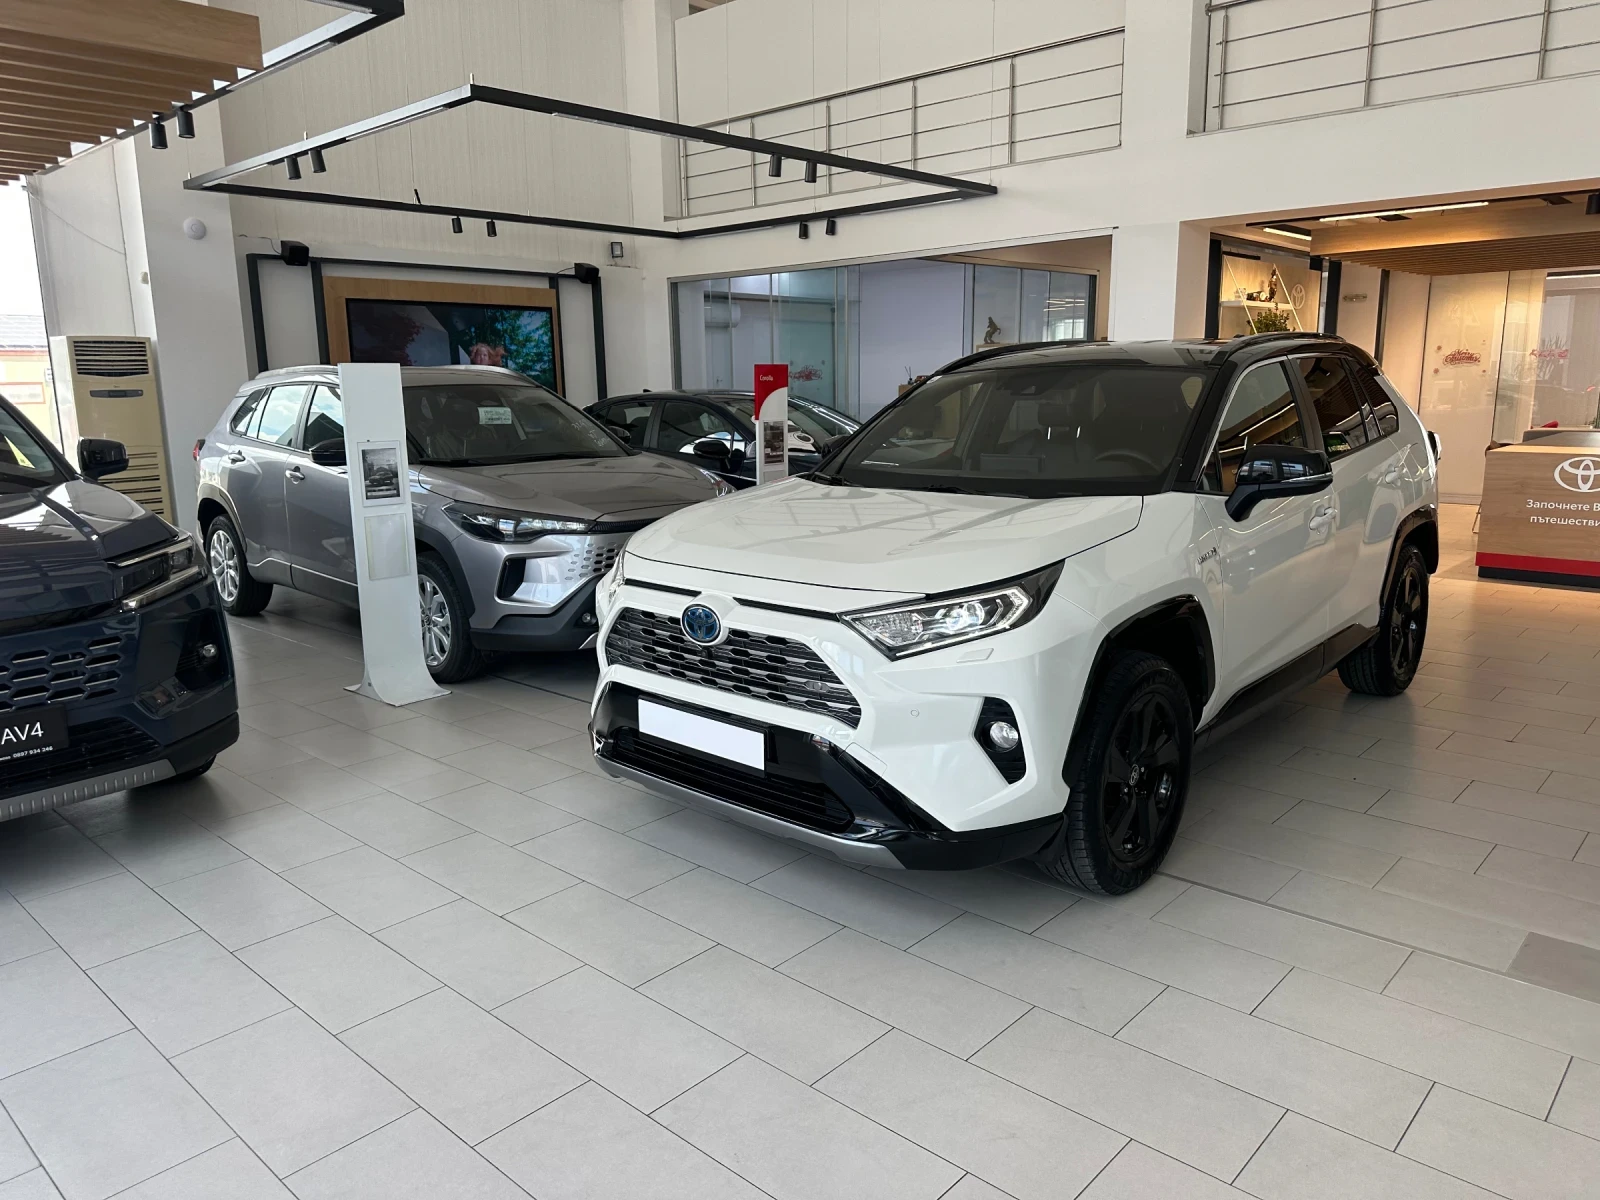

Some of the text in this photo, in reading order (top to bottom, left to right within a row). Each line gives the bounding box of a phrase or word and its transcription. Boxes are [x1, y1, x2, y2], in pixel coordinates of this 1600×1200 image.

[1526, 499, 1600, 512] Започнете В
[1530, 516, 1600, 527] пътешестви
[0, 721, 44, 745] AV4
